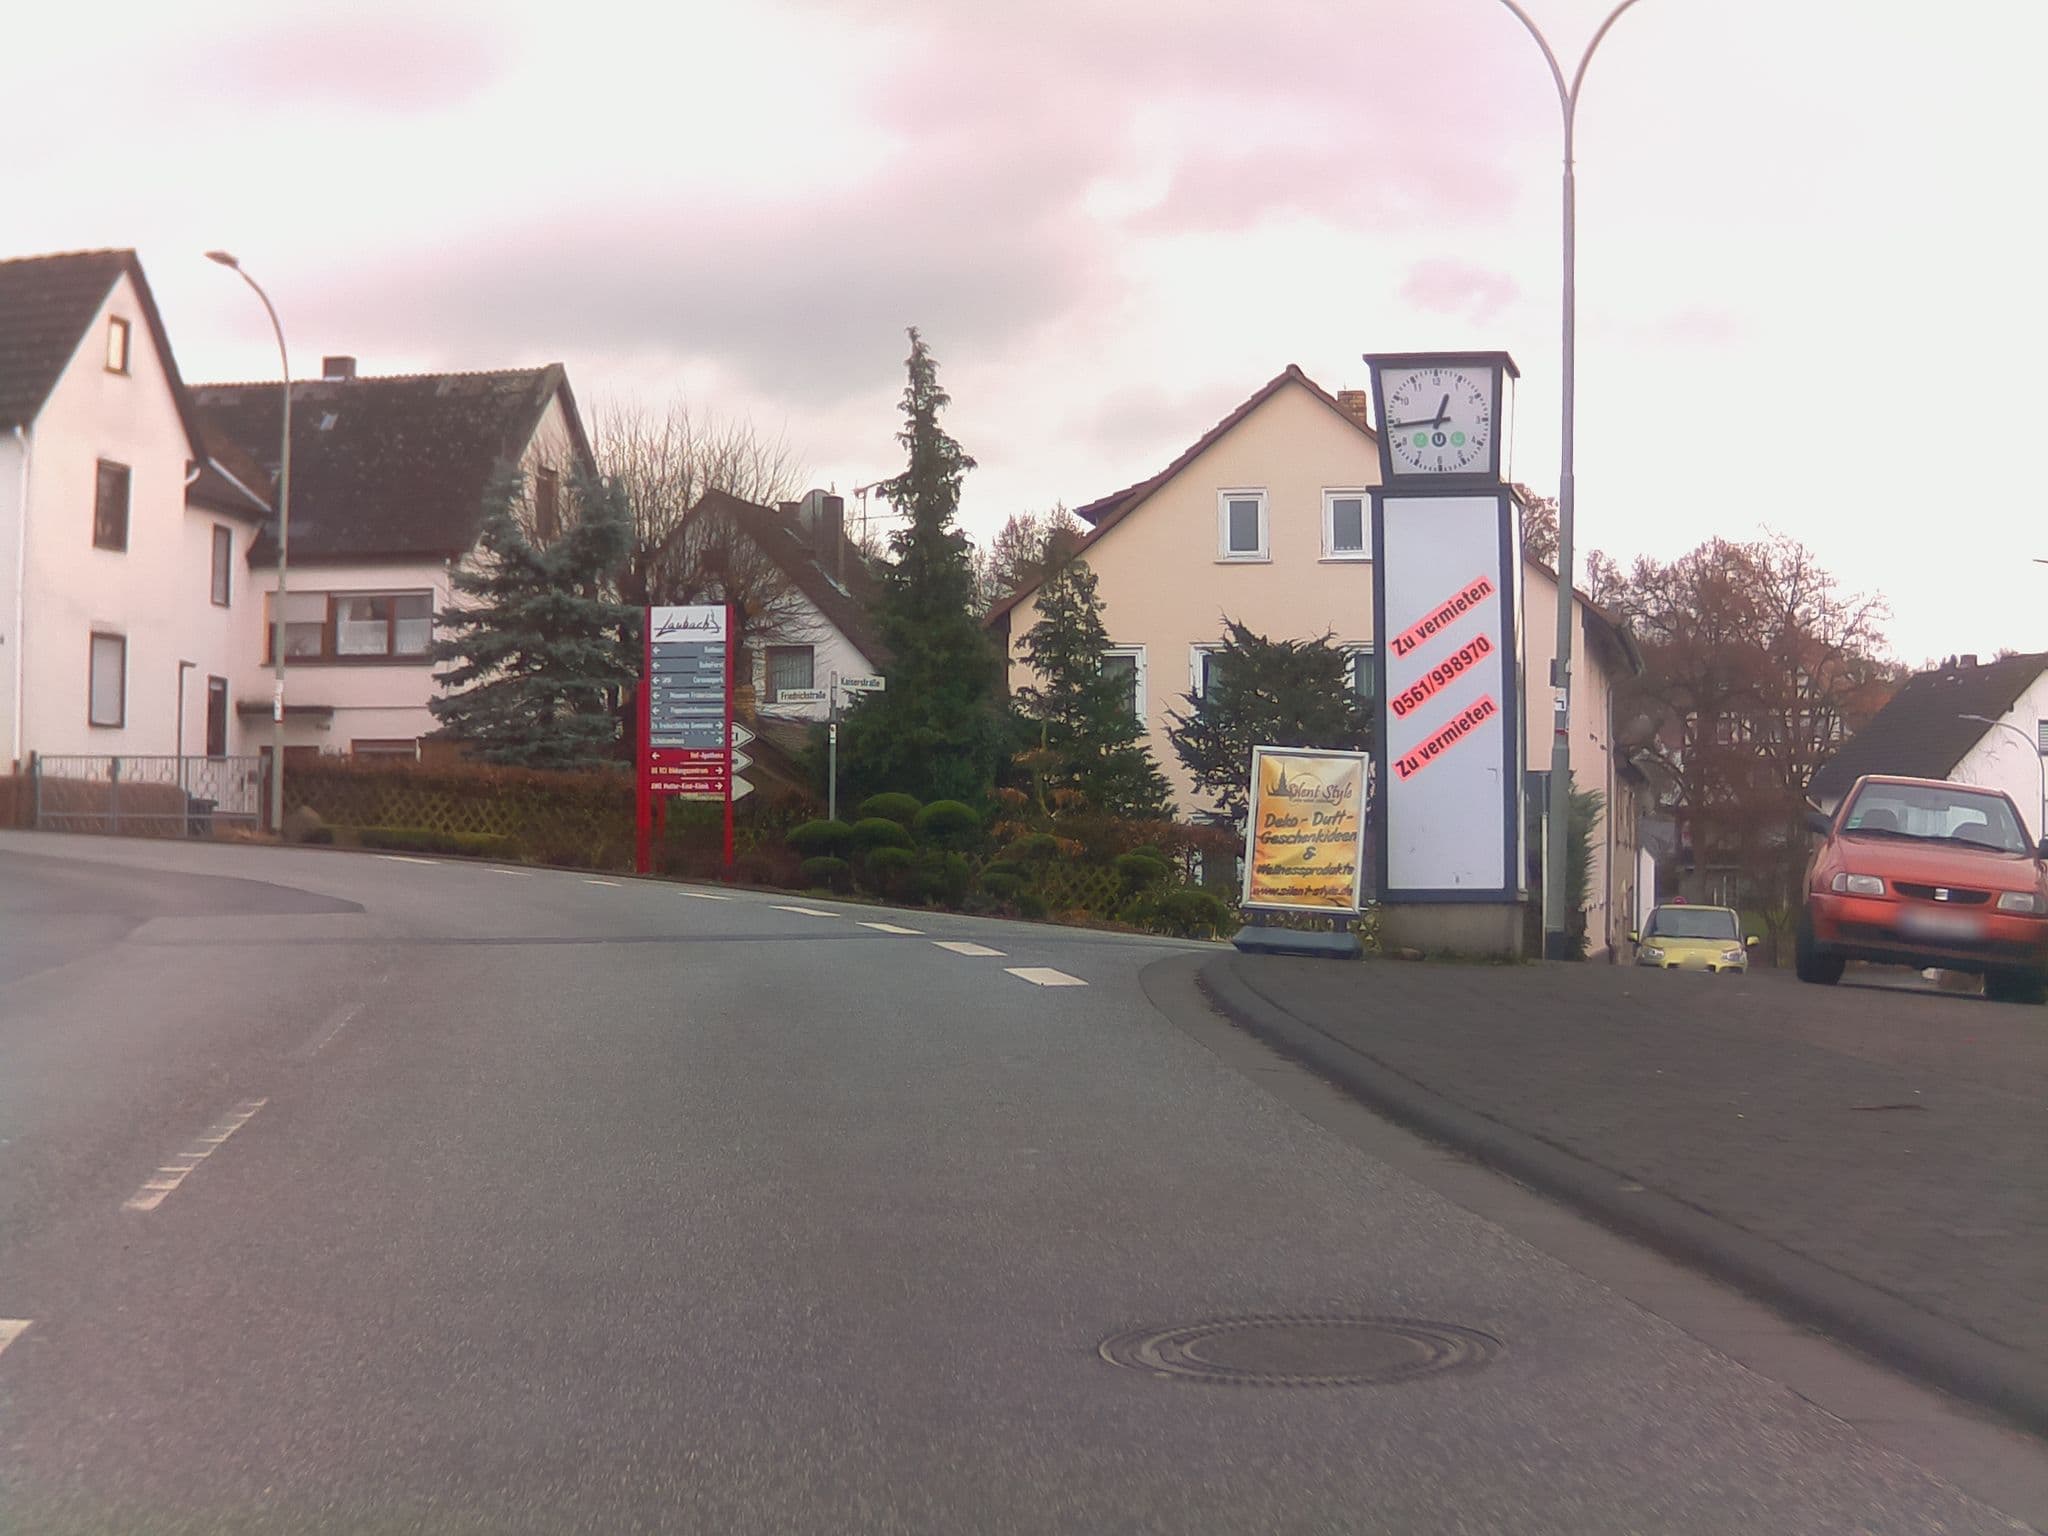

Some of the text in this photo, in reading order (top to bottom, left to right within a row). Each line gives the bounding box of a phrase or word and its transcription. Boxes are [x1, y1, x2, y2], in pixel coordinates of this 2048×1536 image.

[654, 611, 711, 637] Laubach
[1391, 579, 1492, 657] Zu vermieten
[1391, 635, 1490, 717] 0561/998970
[1395, 699, 1495, 778] Zu vermieten
[1322, 782, 1354, 806] Style
[1260, 829, 1358, 845] Geschenkideen
[1303, 846, 1317, 860] &
[1256, 864, 1355, 878] Wellnessprodukte
